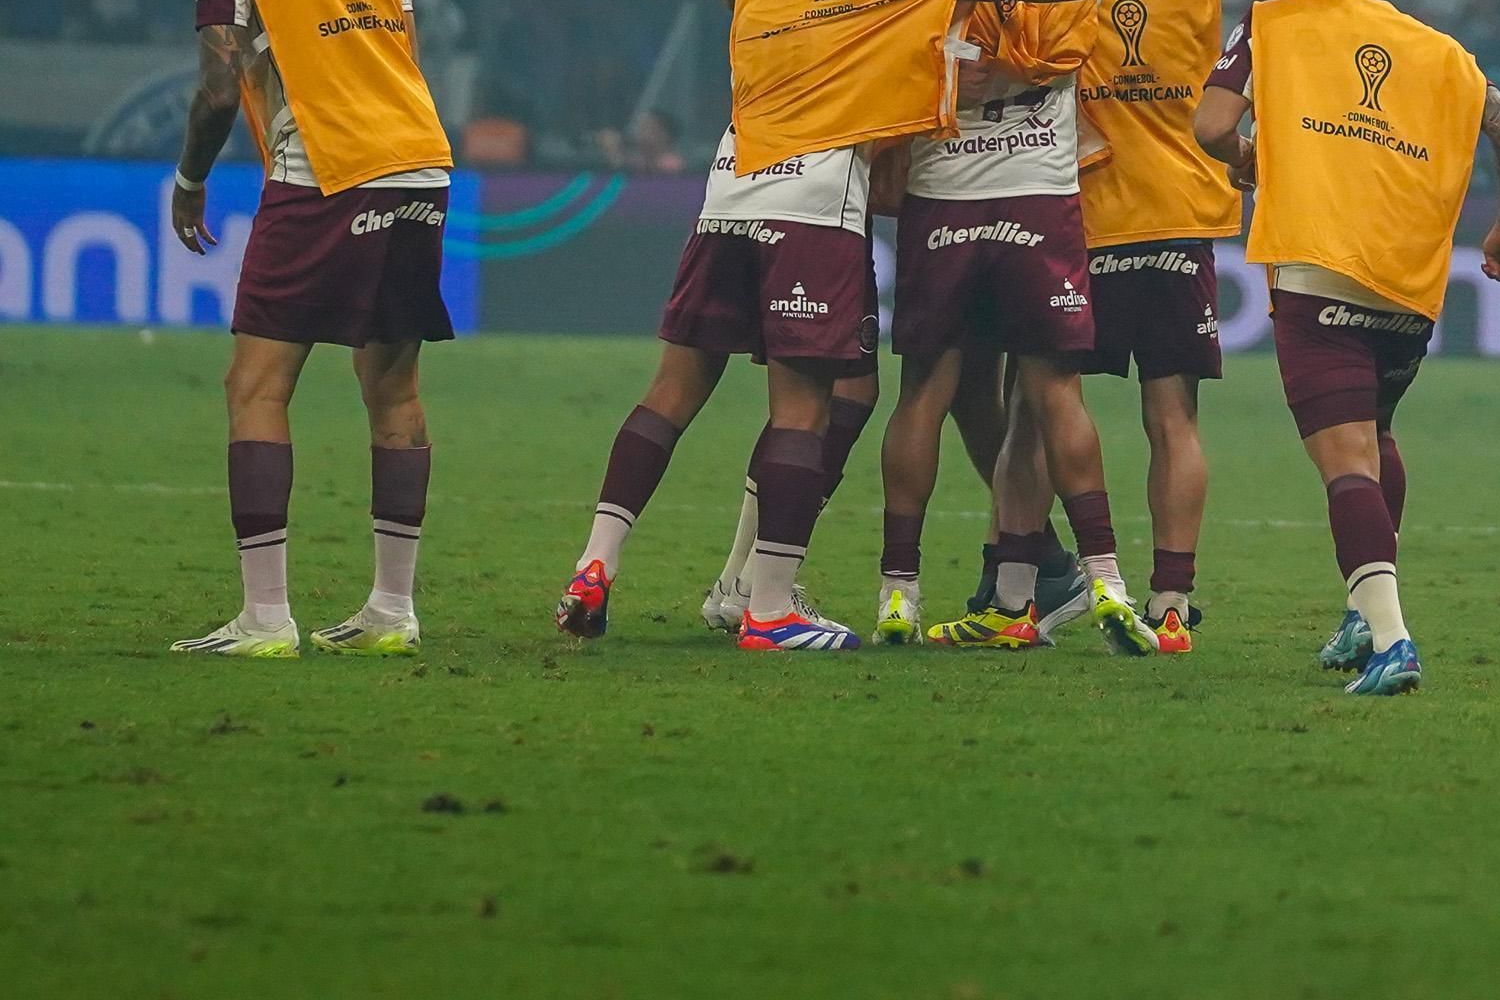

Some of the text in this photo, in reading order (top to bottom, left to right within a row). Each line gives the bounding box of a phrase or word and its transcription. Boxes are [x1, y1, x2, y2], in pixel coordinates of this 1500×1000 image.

[1347, 111, 1391, 132] CONMEBOL
[944, 128, 1057, 155] waterplast
[1301, 116, 1430, 162] SUDAMERICANA
[927, 220, 1045, 250] Chevallier
[769, 296, 829, 314] andina
[1318, 305, 1430, 335] Chevallier
